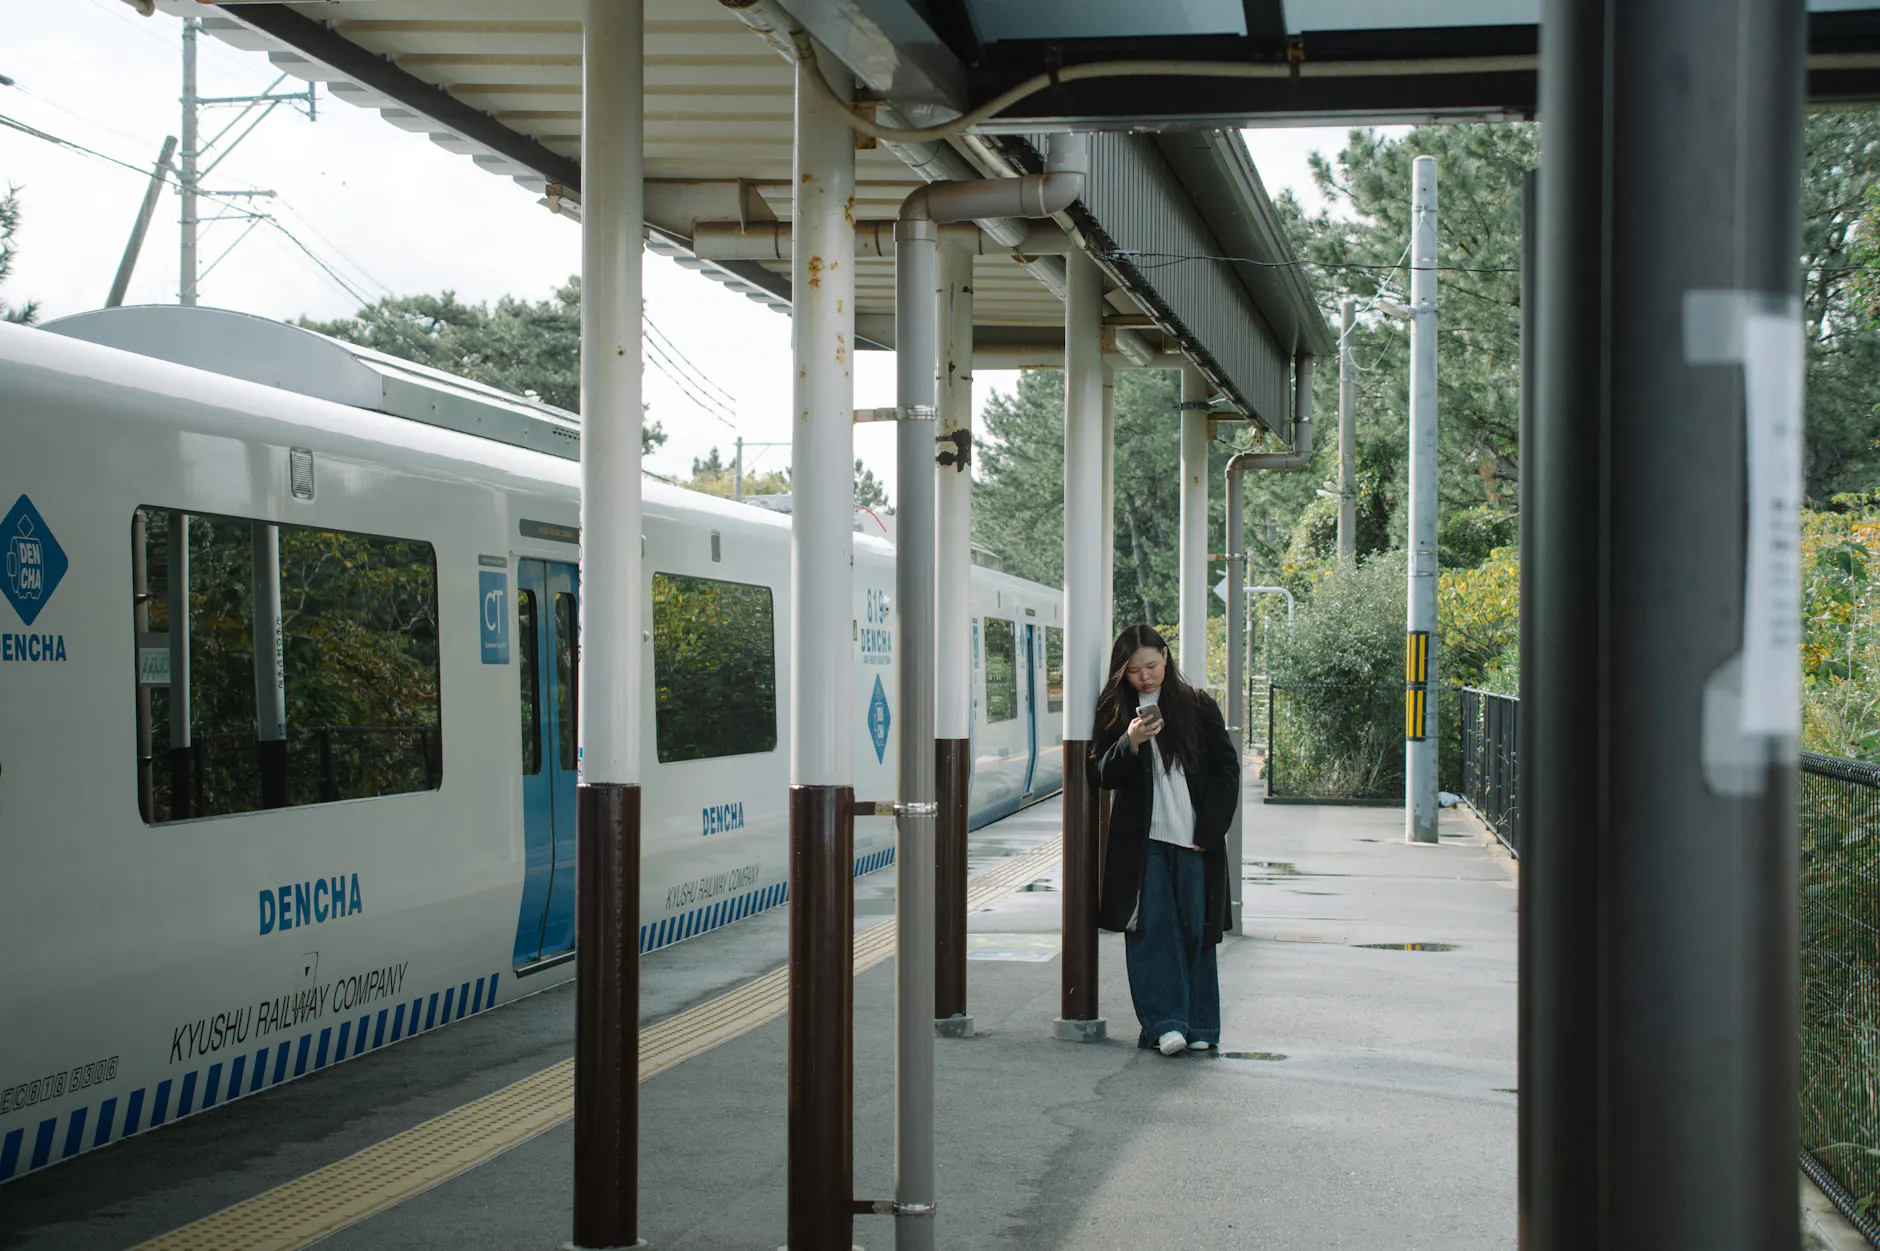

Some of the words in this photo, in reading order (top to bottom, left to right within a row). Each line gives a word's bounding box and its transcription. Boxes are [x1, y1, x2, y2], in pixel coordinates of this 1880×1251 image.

[19, 542, 41, 565] DEN
[20, 568, 41, 590] CHA
[484, 589, 504, 634] CT
[867, 588, 884, 624] 819
[0, 633, 68, 662] ENCHA
[861, 628, 892, 653] DENCHA
[702, 801, 745, 836] DENCHA
[666, 880, 698, 910] KYUSHU
[698, 872, 729, 900] RAILWAY
[728, 862, 762, 892] COMPANY
[259, 872, 363, 936] DENCHA
[170, 1006, 252, 1064] KYUSHU
[255, 984, 330, 1038] RAILWAY
[332, 962, 409, 1014] COMPANY
